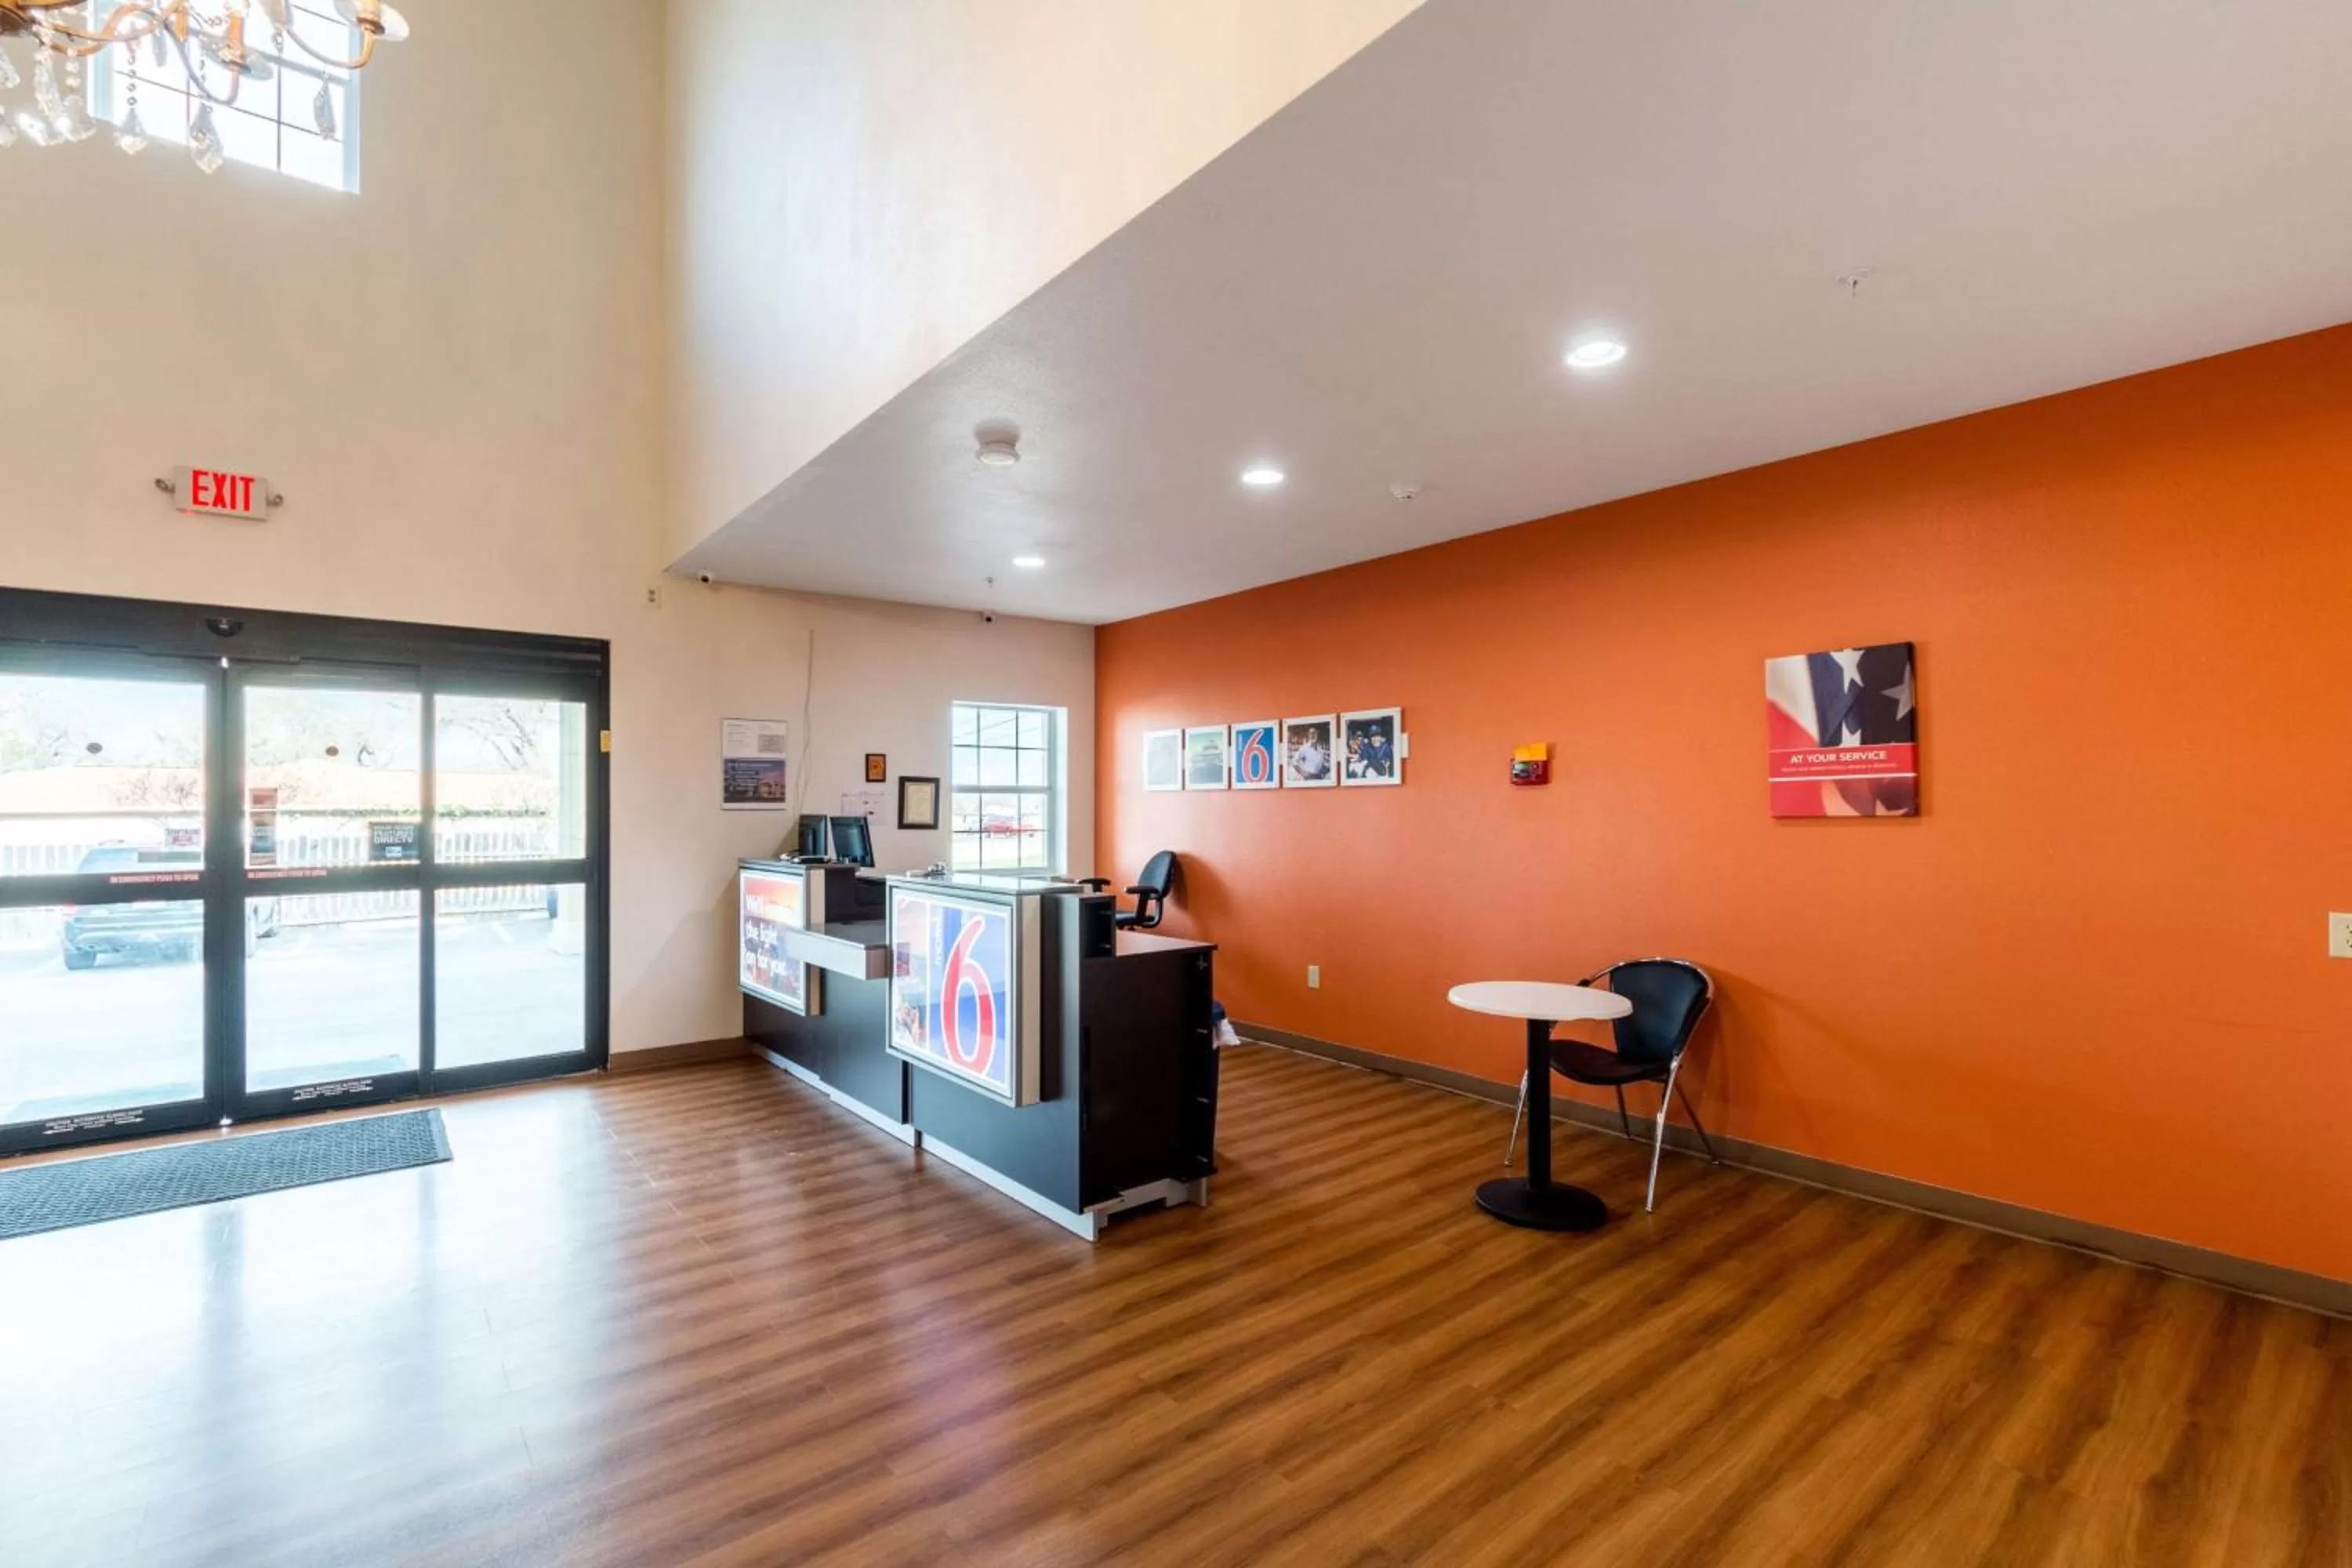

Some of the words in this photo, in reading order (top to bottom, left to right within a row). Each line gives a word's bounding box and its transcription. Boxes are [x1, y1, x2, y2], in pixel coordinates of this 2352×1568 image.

[191, 469, 256, 512] EXIT
[1242, 728, 1269, 783] 6
[1791, 755, 1803, 764] AT
[1806, 753, 1837, 763] YOUR
[1839, 751, 1887, 761] SERVICE
[941, 914, 996, 1076] 6
